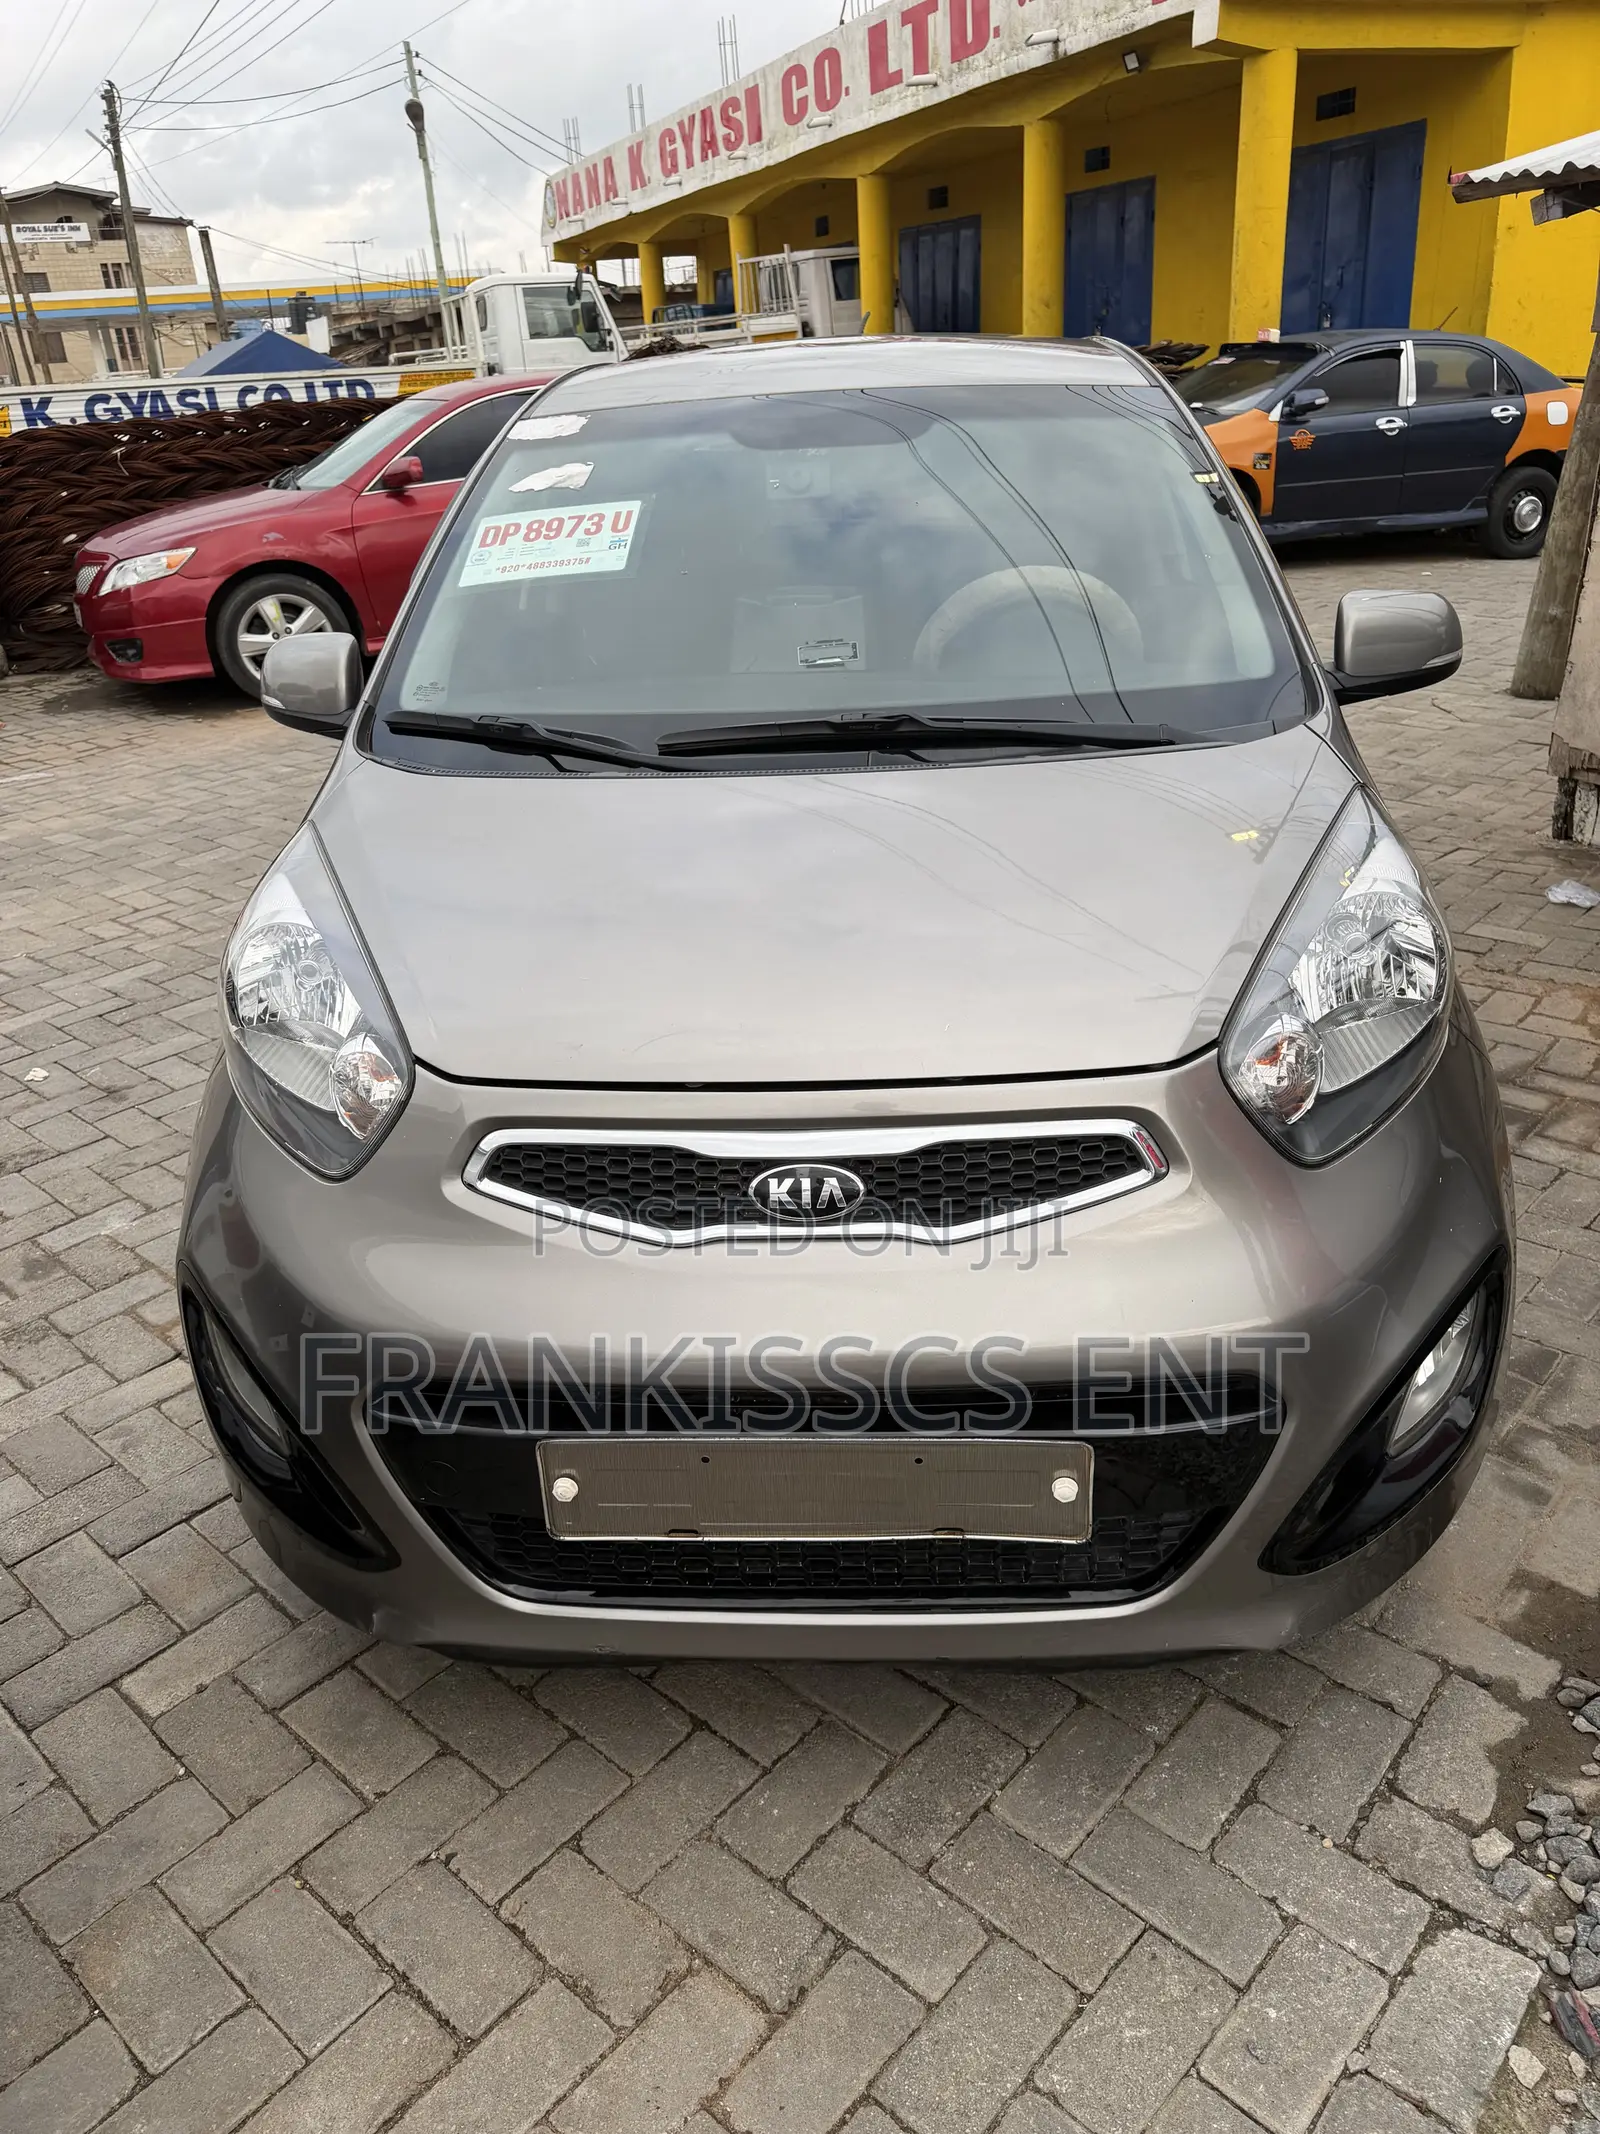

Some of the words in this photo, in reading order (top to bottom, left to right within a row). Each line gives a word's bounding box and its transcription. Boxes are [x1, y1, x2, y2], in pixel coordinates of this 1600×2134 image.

[555, 156, 618, 220] NANA
[659, 84, 763, 178] GYASI
[781, 47, 850, 126] CO.
[84, 387, 219, 423] GYASI
[478, 522, 522, 548] DP
[522, 512, 606, 543] 8973
[610, 510, 634, 533] U
[608, 542, 628, 551] GH
[767, 1177, 846, 1208] KIA
